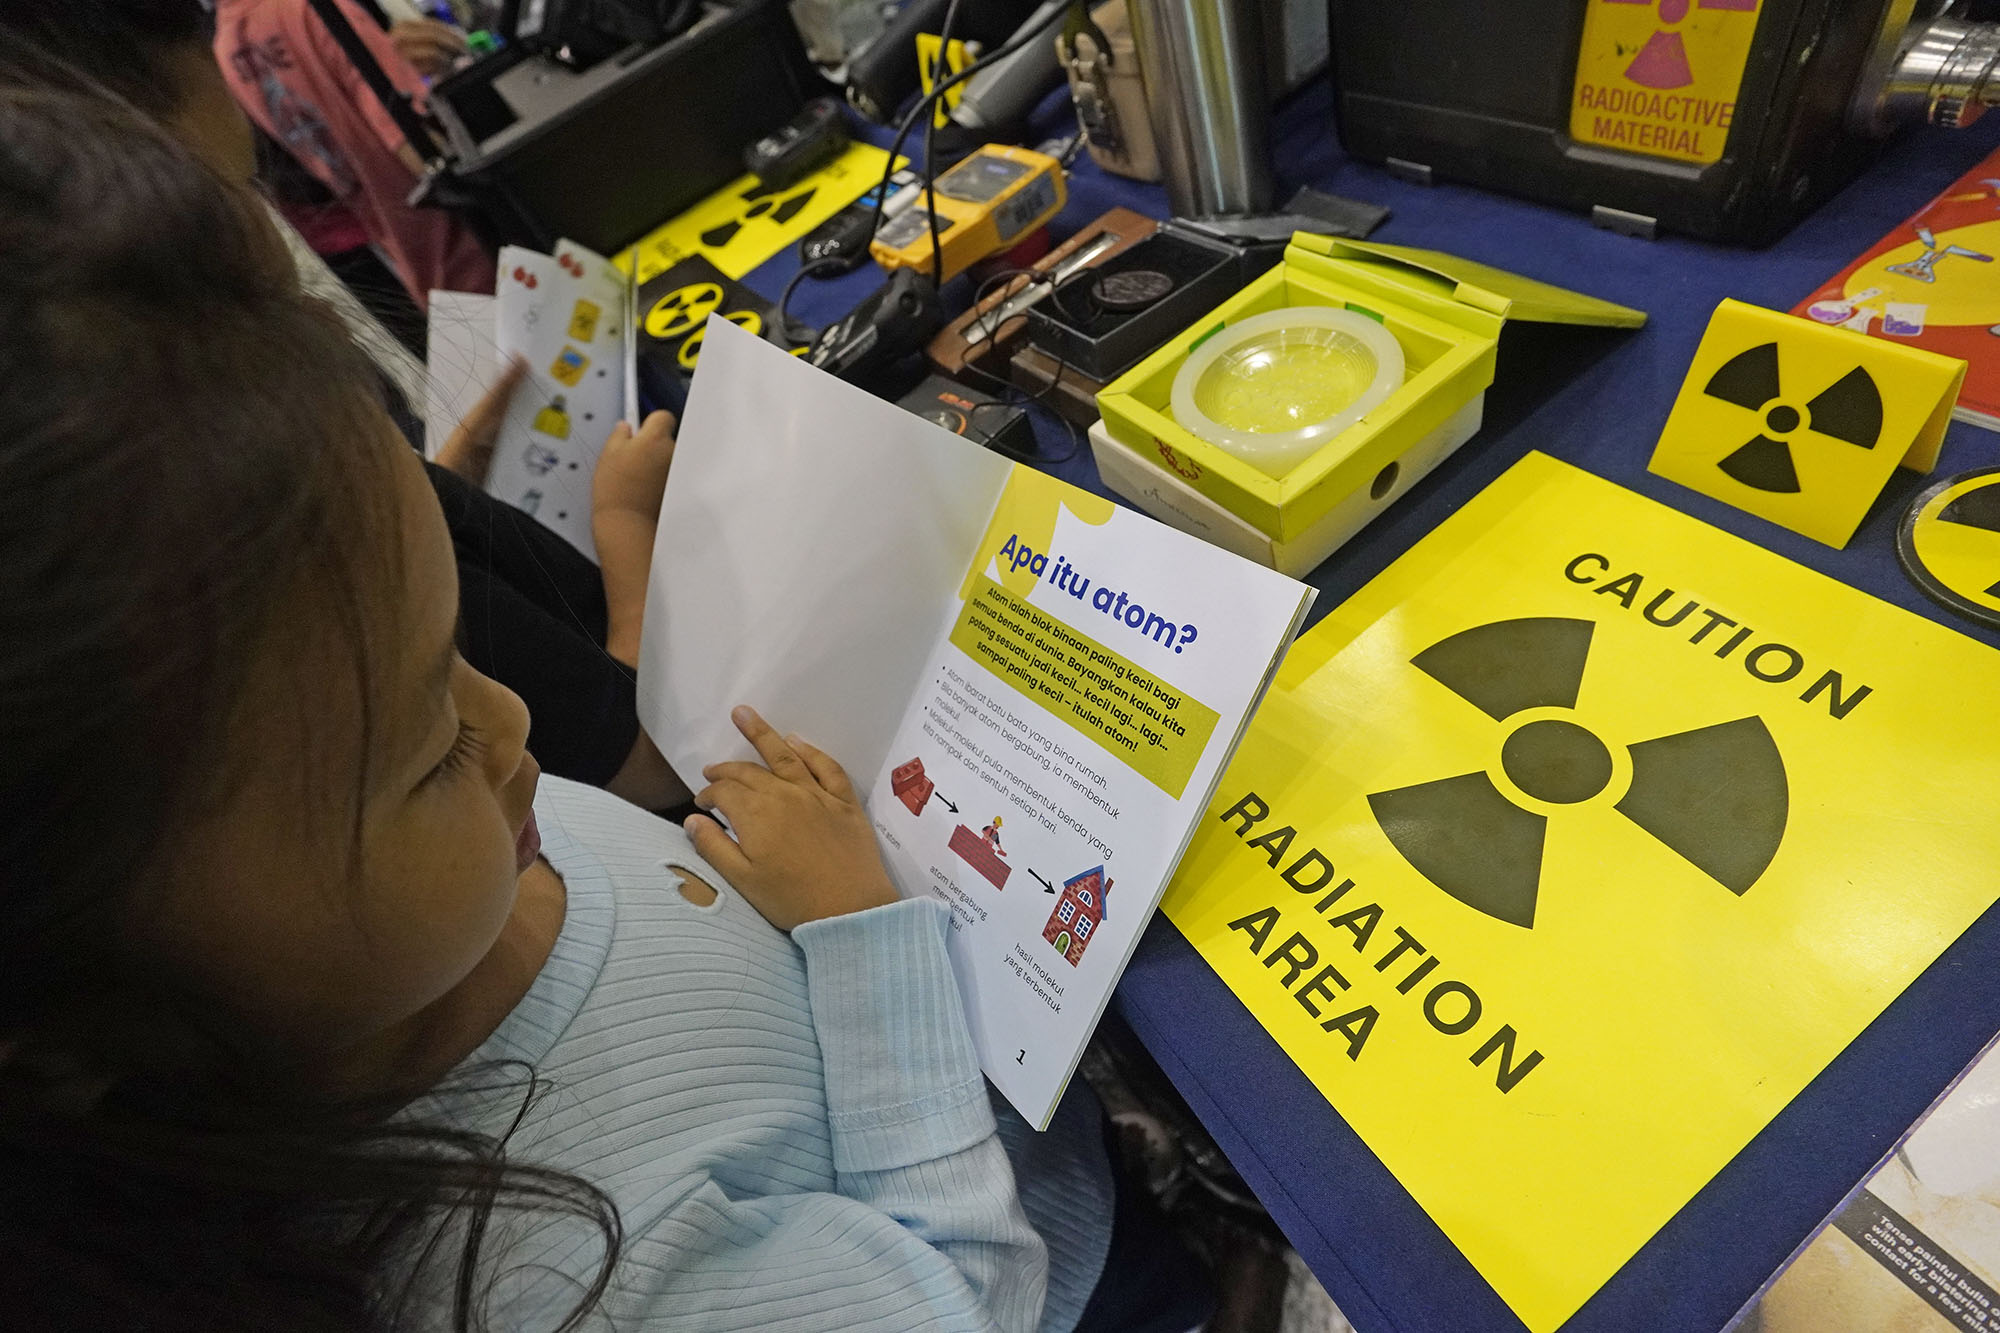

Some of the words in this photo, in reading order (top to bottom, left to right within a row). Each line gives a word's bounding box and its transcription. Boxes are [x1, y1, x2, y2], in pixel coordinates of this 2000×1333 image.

[1580, 84, 1735, 128] RADIOACTIVE
[1593, 117, 1704, 156] MATERIAL
[987, 587, 1009, 607] Atom
[1008, 600, 1030, 620] ialah
[1031, 613, 1053, 633] blok
[1052, 626, 1089, 655] binaan
[1089, 650, 1125, 678] paling
[1126, 669, 1153, 693] kecil
[1153, 685, 1181, 710] bagi
[999, 534, 1049, 577] Apa
[1048, 556, 1090, 600] itu
[1092, 587, 1198, 654] atom?
[1563, 552, 1873, 720] CAUTION
[968, 616, 996, 641] potong
[995, 634, 1031, 661] sesuatu
[1029, 654, 1051, 674] jadi
[1051, 667, 1082, 695] kecil...
[1084, 688, 1111, 711] kecil
[1110, 704, 1138, 730] lagi...
[1139, 723, 1168, 751] lagi...
[972, 598, 998, 619] semua
[997, 613, 1024, 637] benda
[1025, 632, 1036, 643] di
[1035, 638, 1065, 663] dunia.
[1067, 657, 1131, 701] Bayangkan
[1129, 694, 1161, 722] kalau
[1162, 714, 1186, 737] kita
[977, 641, 1009, 667] sampai
[1006, 662, 1038, 689] paling
[1038, 681, 1064, 703] kecil
[1072, 702, 1103, 729] itulah
[1105, 725, 1138, 752] atom!
[923, 720, 935, 737] kita
[934, 732, 963, 760] nampak
[963, 757, 980, 774] dan
[980, 771, 1009, 797] sentuh
[1009, 793, 1037, 818] setiap
[1038, 813, 1057, 835] hari.
[929, 708, 985, 759] Molekul-molekul
[983, 754, 1003, 773] pula
[1003, 769, 1057, 813] membentuk
[1057, 808, 1088, 837] benda
[1087, 834, 1113, 860] yang
[947, 669, 965, 687] Atom
[986, 697, 1006, 718] batu
[1007, 712, 1028, 733] bata
[1028, 729, 1052, 752] yang
[1053, 743, 1075, 765] bina
[1075, 761, 1107, 790] rumah.
[952, 691, 979, 716] banyak
[979, 712, 1000, 733] atom
[1001, 727, 1051, 770] bergabung,
[1053, 763, 1062, 776] ia
[1063, 772, 1120, 820] membentuk
[929, 865, 949, 886] atom
[948, 881, 988, 921] bergabung
[933, 885, 975, 926] membentuk
[1219, 792, 1544, 1094] RADIATION
[1003, 953, 1023, 977] yang
[1022, 971, 1061, 1014] terbentuk
[1014, 942, 1034, 966] hasil
[1032, 963, 1065, 998] molekul
[1227, 907, 1380, 1062] AREA
[1016, 1048, 1026, 1066] 1
[1864, 1233, 1909, 1270] contact
[1908, 1268, 1927, 1284] for
[1927, 1285, 1937, 1294] a
[1938, 1292, 1962, 1314] few
[1962, 1313, 1989, 1333] min
[1872, 1225, 1896, 1246] with
[1897, 1246, 1928, 1271] early
[1928, 1270, 1988, 1322] blistering
[1989, 1320, 2000, 1333] w
[1880, 1215, 1914, 1246] Tense
[1913, 1246, 1958, 1281] Painful
[1957, 1279, 1990, 1308] bulla
